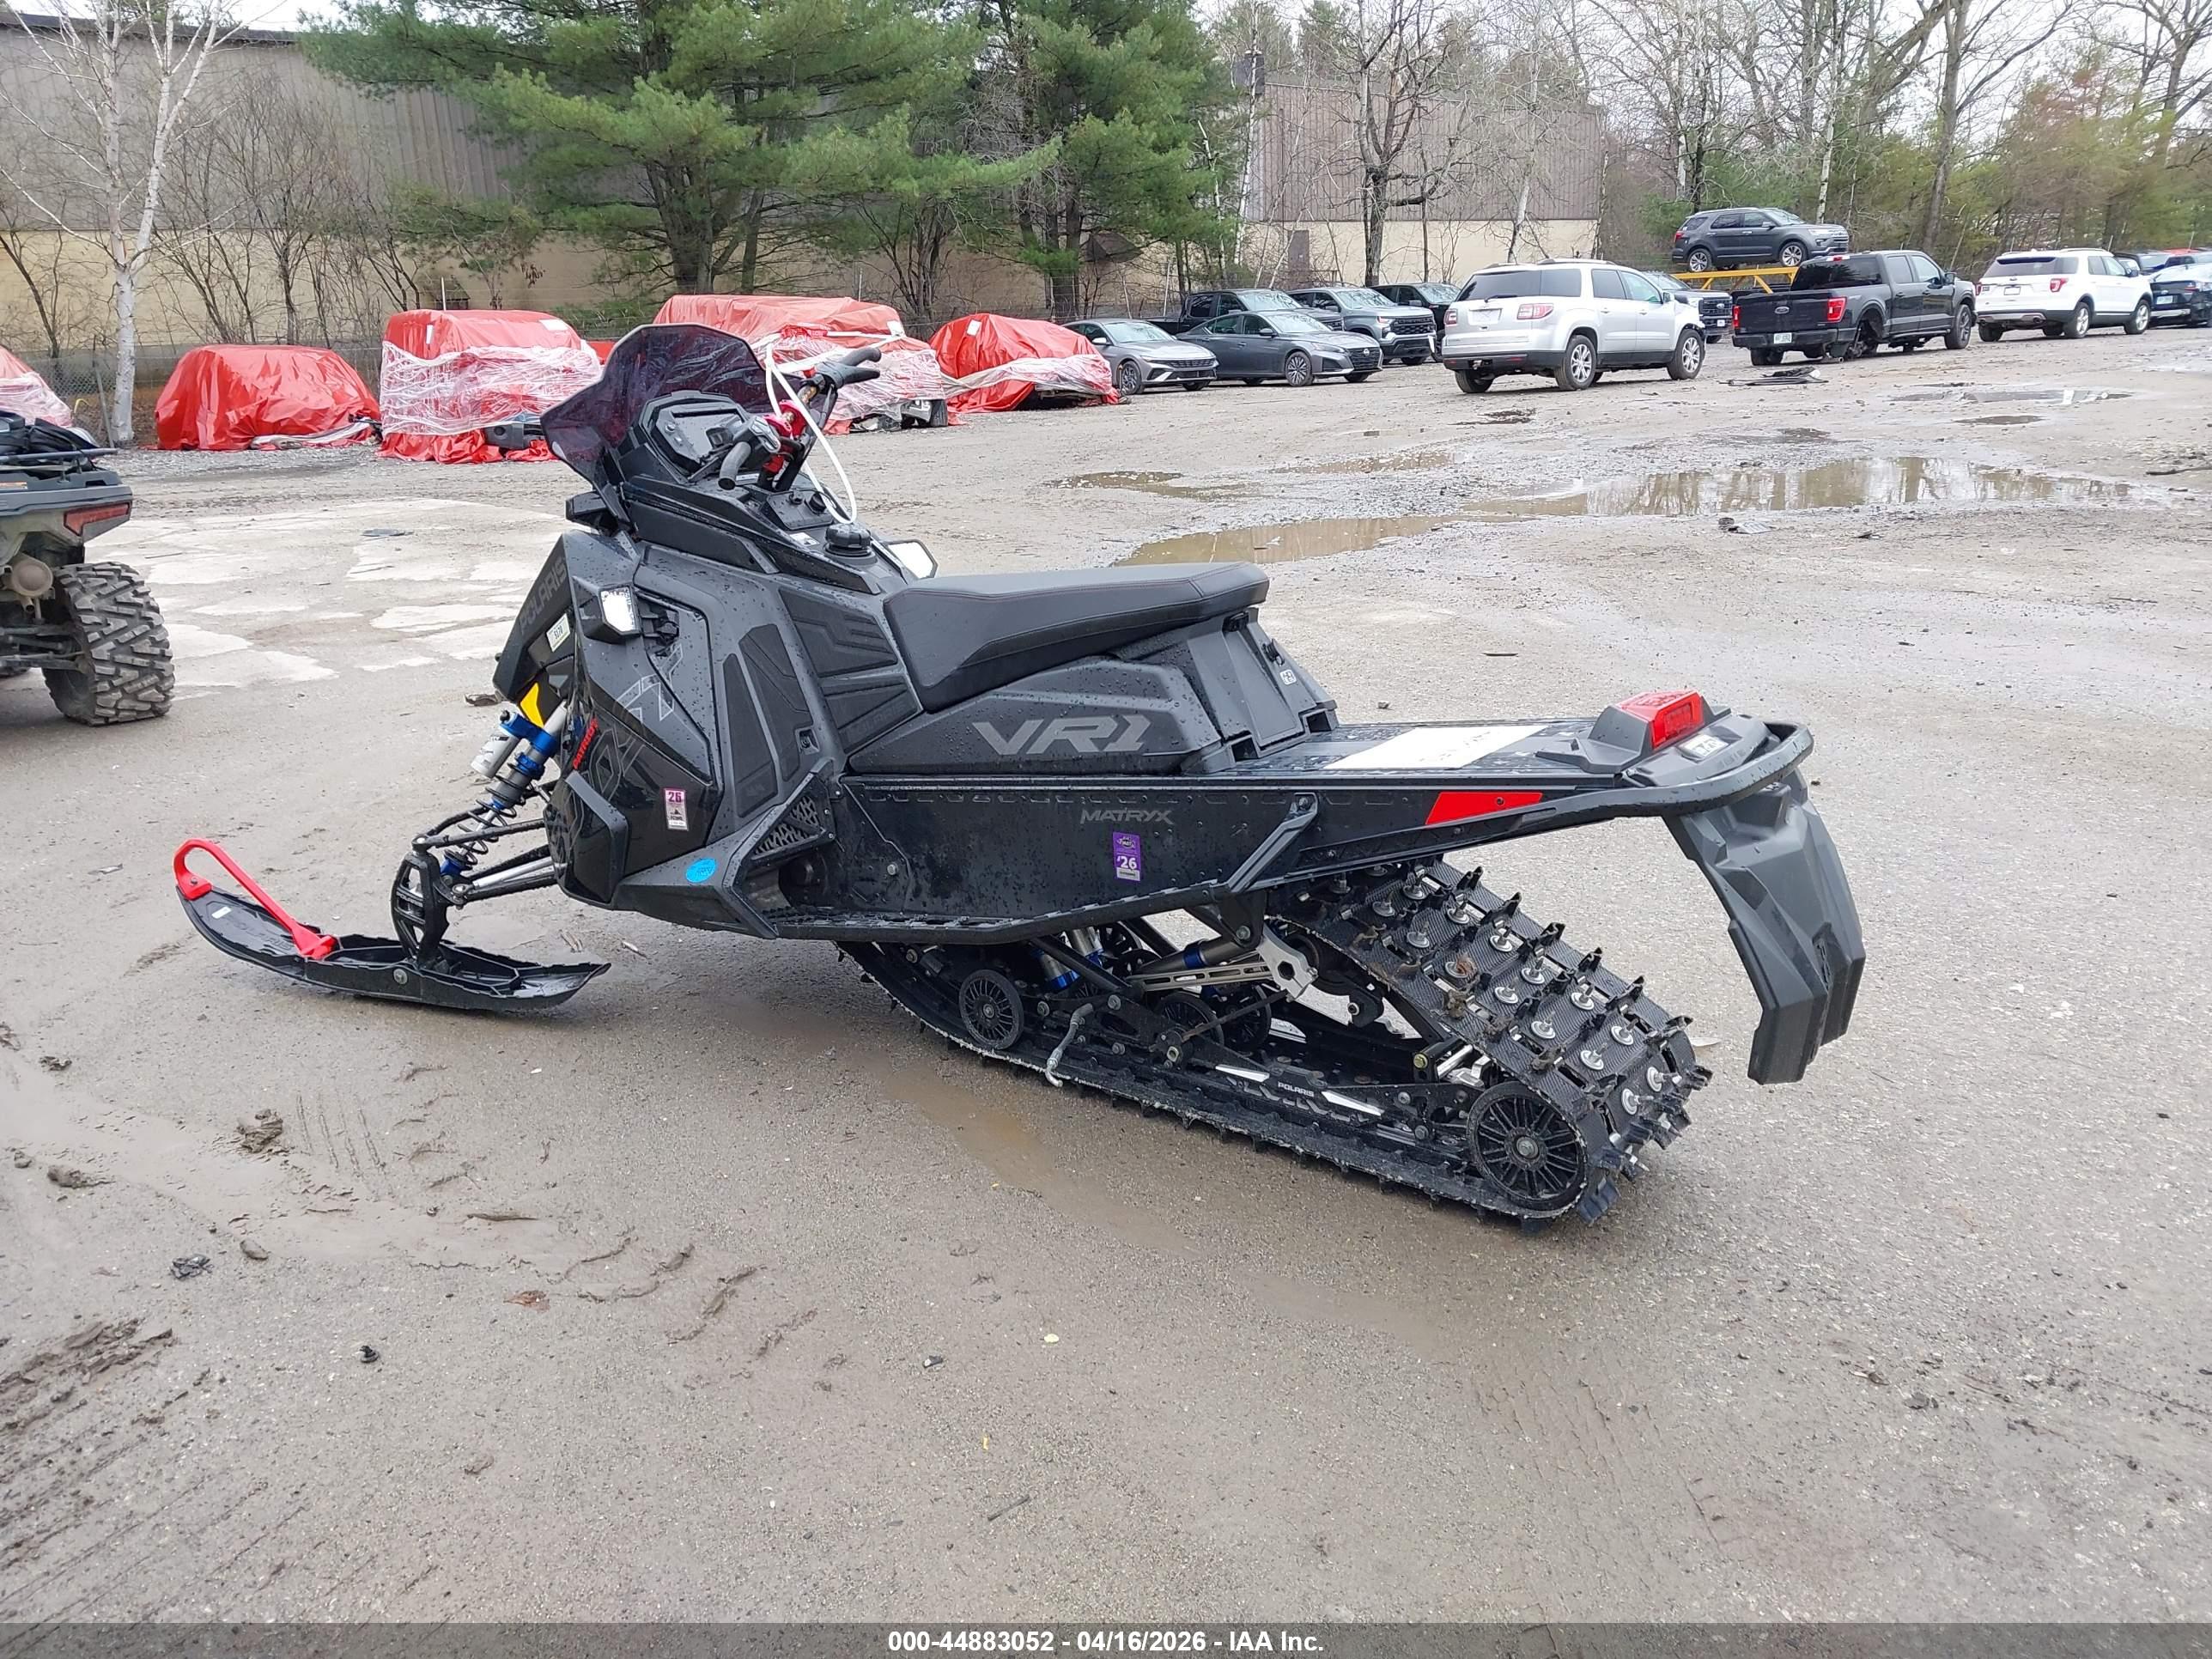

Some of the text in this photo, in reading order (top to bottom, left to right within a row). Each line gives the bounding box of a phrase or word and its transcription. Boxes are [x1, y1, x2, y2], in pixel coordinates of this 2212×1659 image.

[519, 556, 568, 635] POLARIS
[972, 714, 1152, 756] VR1
[668, 791, 682, 803] 26
[1080, 809, 1175, 825] MATRYX
[1278, 1081, 1315, 1098] POLARIS
